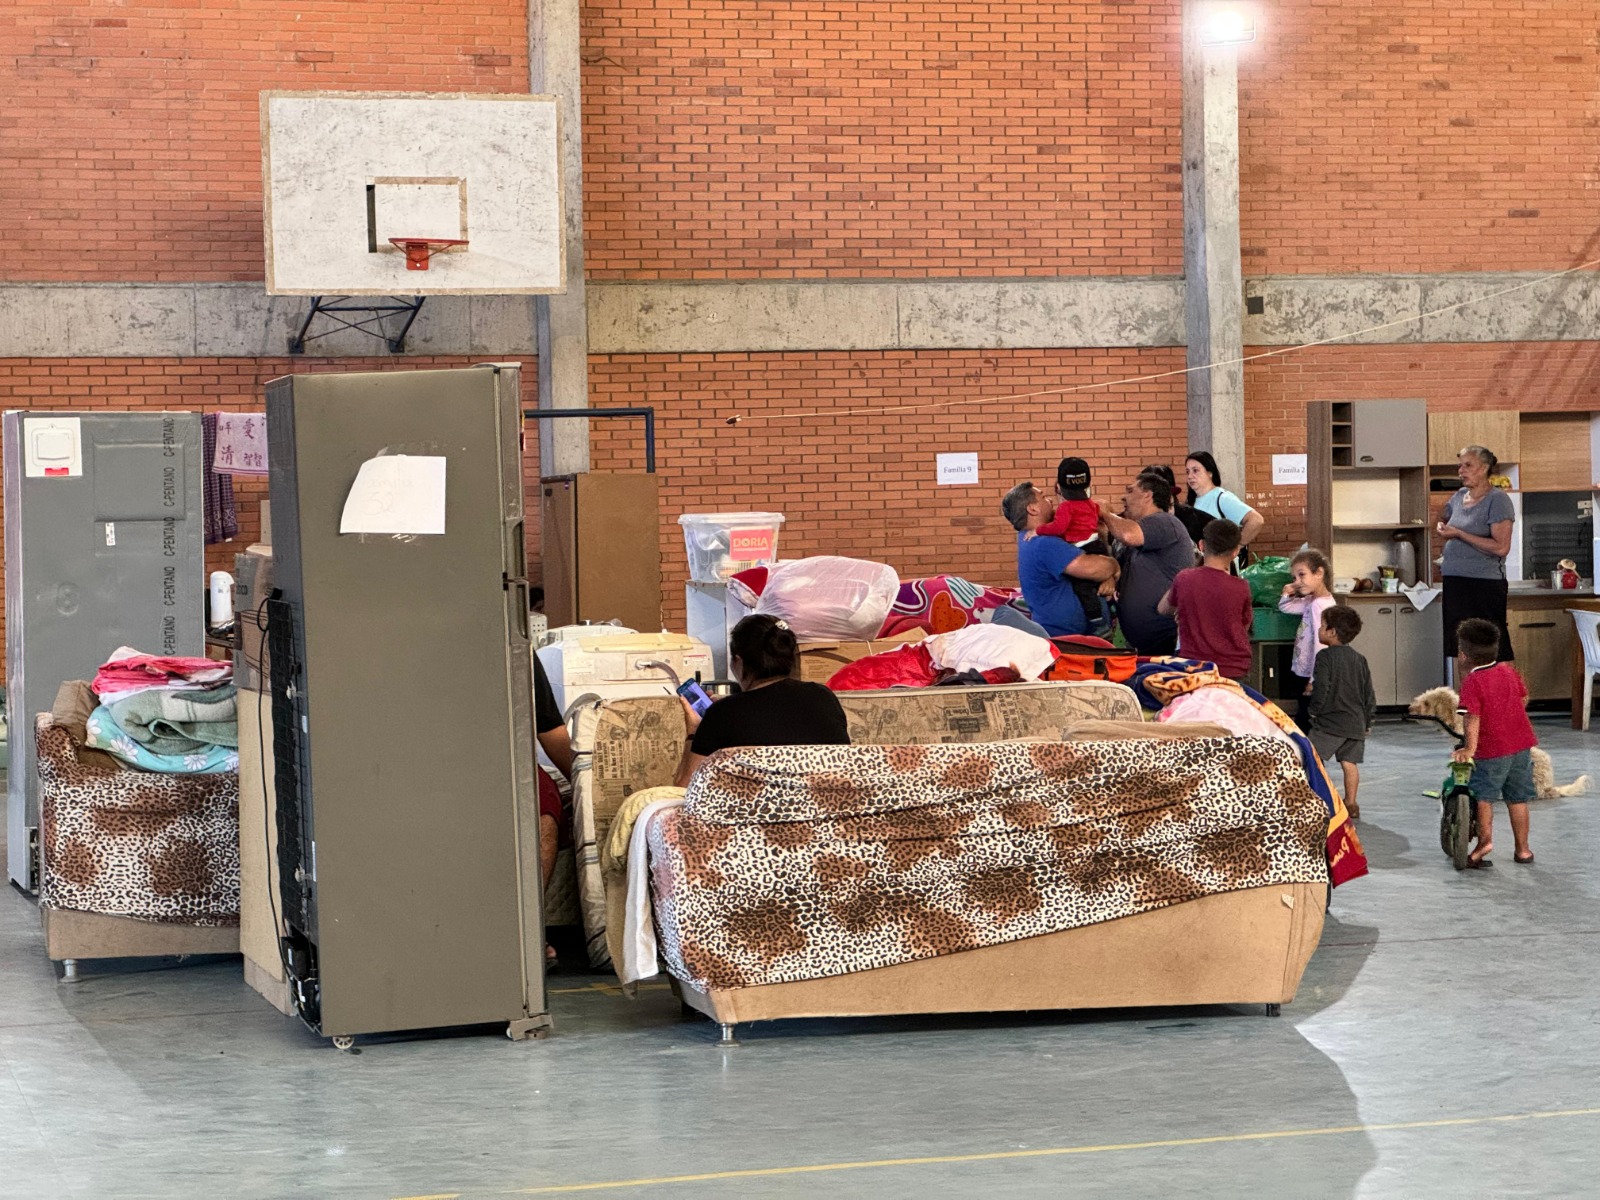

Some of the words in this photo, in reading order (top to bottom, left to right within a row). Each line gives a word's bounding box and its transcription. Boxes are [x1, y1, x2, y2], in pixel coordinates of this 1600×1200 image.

[163, 467, 176, 507] C-PENTANO
[163, 517, 176, 556] C-PENTANO
[733, 537, 769, 549] DORIA
[163, 566, 176, 606] C-PENTANO
